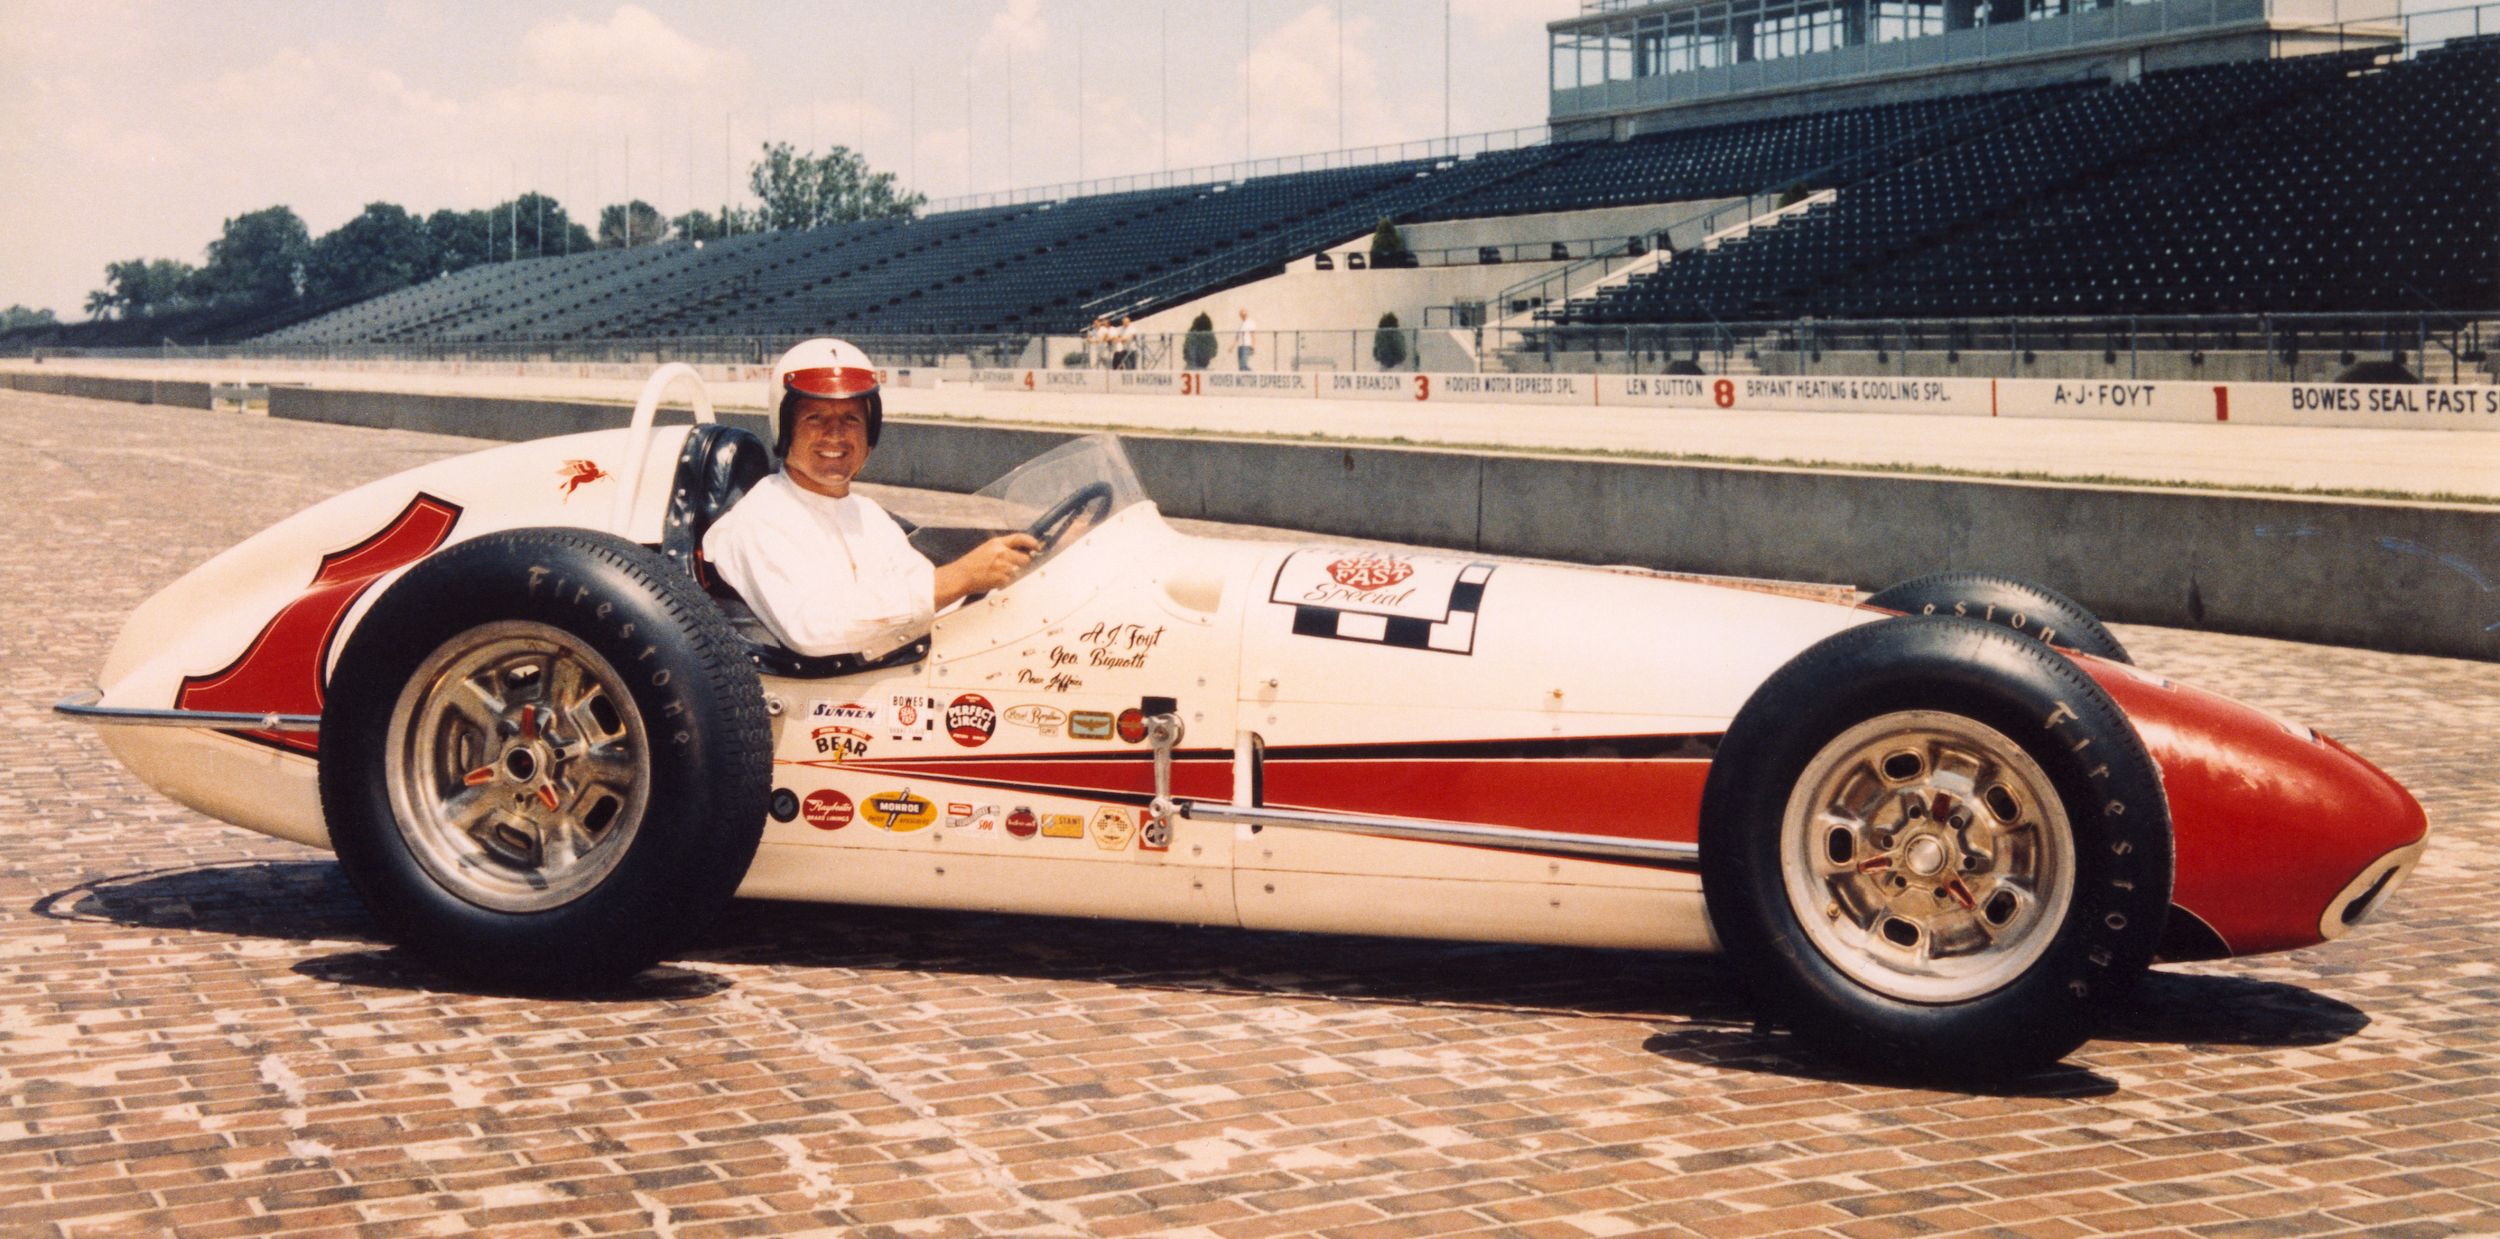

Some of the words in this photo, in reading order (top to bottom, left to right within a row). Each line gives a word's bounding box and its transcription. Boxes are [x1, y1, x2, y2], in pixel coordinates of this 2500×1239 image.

[1023, 371, 1035, 391] 4
[1181, 373, 1200, 396] 31
[1236, 374, 1257, 387] MOTOR
[1260, 375, 1290, 389] EXPRESS
[1333, 375, 1351, 390] DON
[1356, 375, 1401, 391] BRANSON
[1414, 375, 1430, 401] 3
[1445, 377, 1481, 392] HOOVER
[1484, 377, 1512, 393] MOTOR
[1515, 378, 1553, 394] EXPRESS
[1556, 378, 1578, 395] SPL.
[1626, 379, 1648, 396] LEN
[1655, 379, 1703, 396] SUTTON
[1747, 380, 1792, 398] BRYANT
[1797, 380, 1847, 400] HEATING
[1850, 383, 1859, 400] &
[1862, 383, 1919, 401] COOLING
[1924, 384, 1951, 401] SPL.
[1713, 379, 1735, 409] 8
[2099, 386, 2156, 407] FOYT
[2213, 386, 2229, 421] 1
[2292, 387, 2361, 413] BOWES
[2367, 389, 2419, 412] SEAL
[2426, 389, 2478, 414] FAST
[1336, 568, 1413, 586] FAST
[1303, 583, 1417, 607] Special
[1125, 624, 1167, 652] Foyt
[527, 565, 690, 744] Firestone
[1050, 645, 1078, 669] Geo.
[1090, 647, 1148, 670] Bignotti
[892, 695, 924, 707] BOWES
[947, 705, 996, 722] PERFECT
[949, 715, 992, 732] CIRCLE
[815, 736, 868, 758] BEAR
[879, 802, 920, 813] MONROE
[2044, 700, 2136, 999] Firestone
